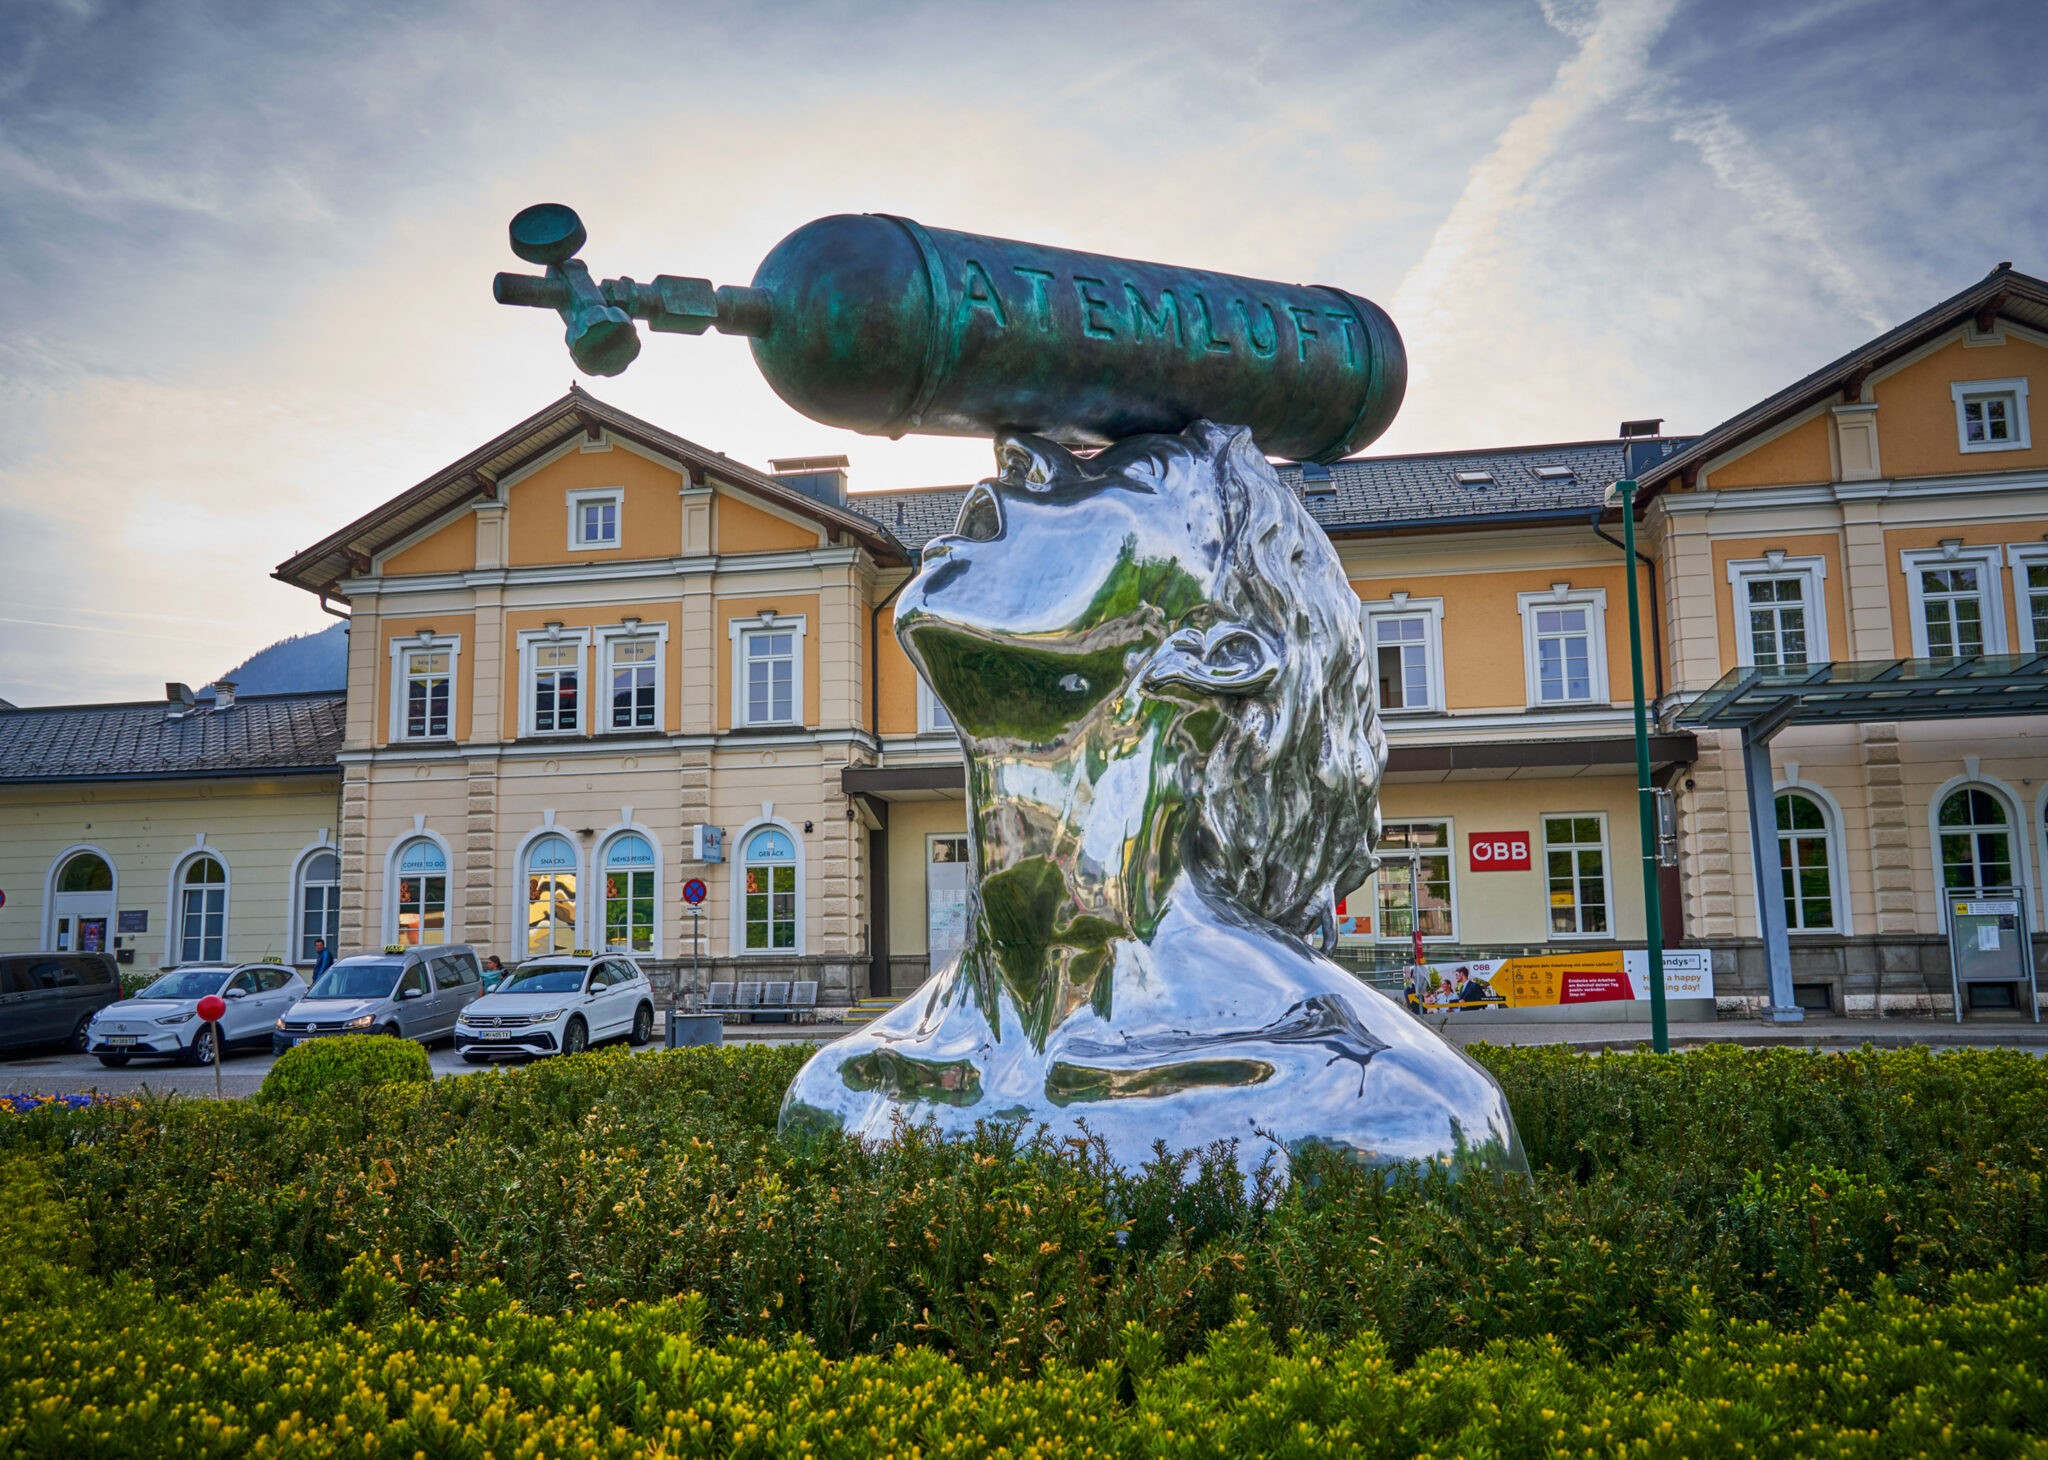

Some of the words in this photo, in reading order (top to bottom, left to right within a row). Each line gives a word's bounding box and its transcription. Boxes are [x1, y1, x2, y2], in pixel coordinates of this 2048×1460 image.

[958, 258, 1358, 367] ATEMLUFT
[1472, 841, 1528, 861] ÖBB
[612, 855, 651, 863] MEHLSPEISEN
[1674, 974, 1702, 983] happy
[1643, 983, 1680, 992] wing
[1681, 983, 1700, 992] day!
